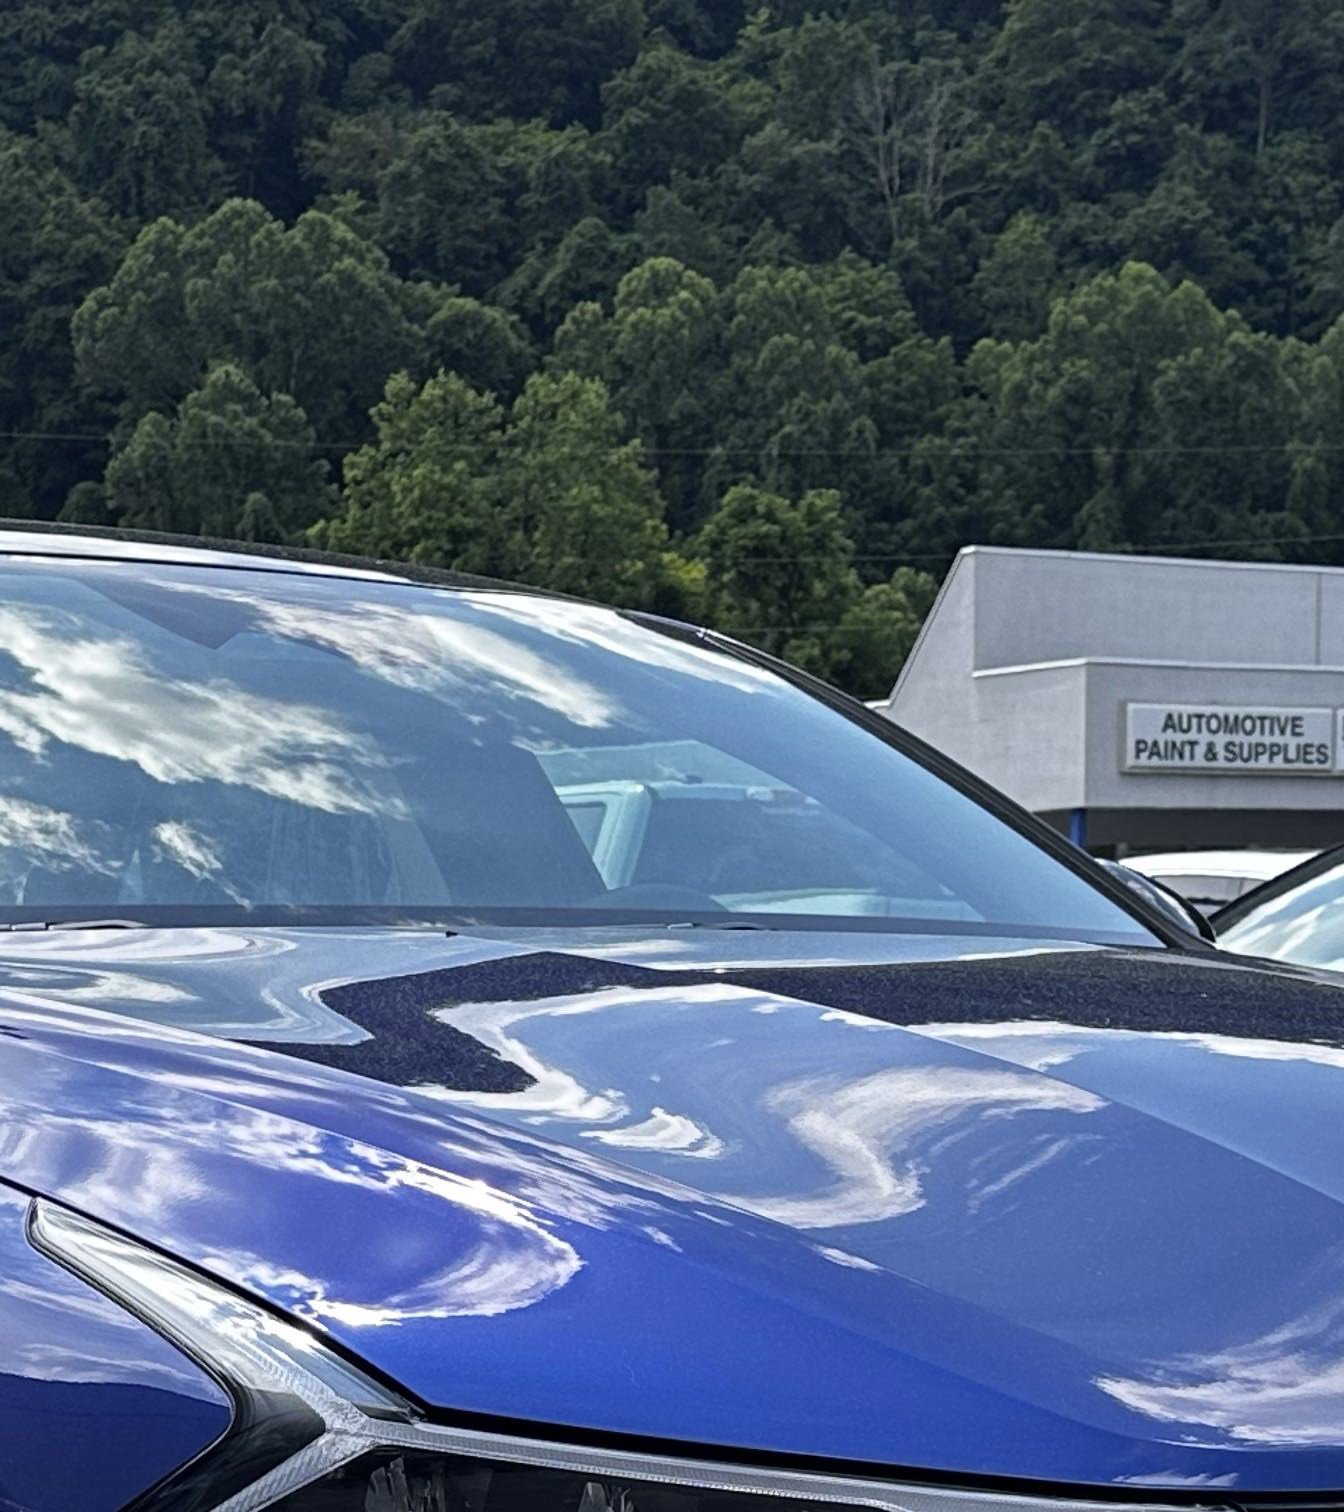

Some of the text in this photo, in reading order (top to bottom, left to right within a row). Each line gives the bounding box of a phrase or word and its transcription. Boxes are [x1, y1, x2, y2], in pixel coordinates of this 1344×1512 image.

[1162, 713, 1304, 737] AUTOMOTIVE
[1134, 738, 1199, 762] PAINT
[1205, 740, 1219, 762] &
[1223, 740, 1329, 765] SUPPLIES
